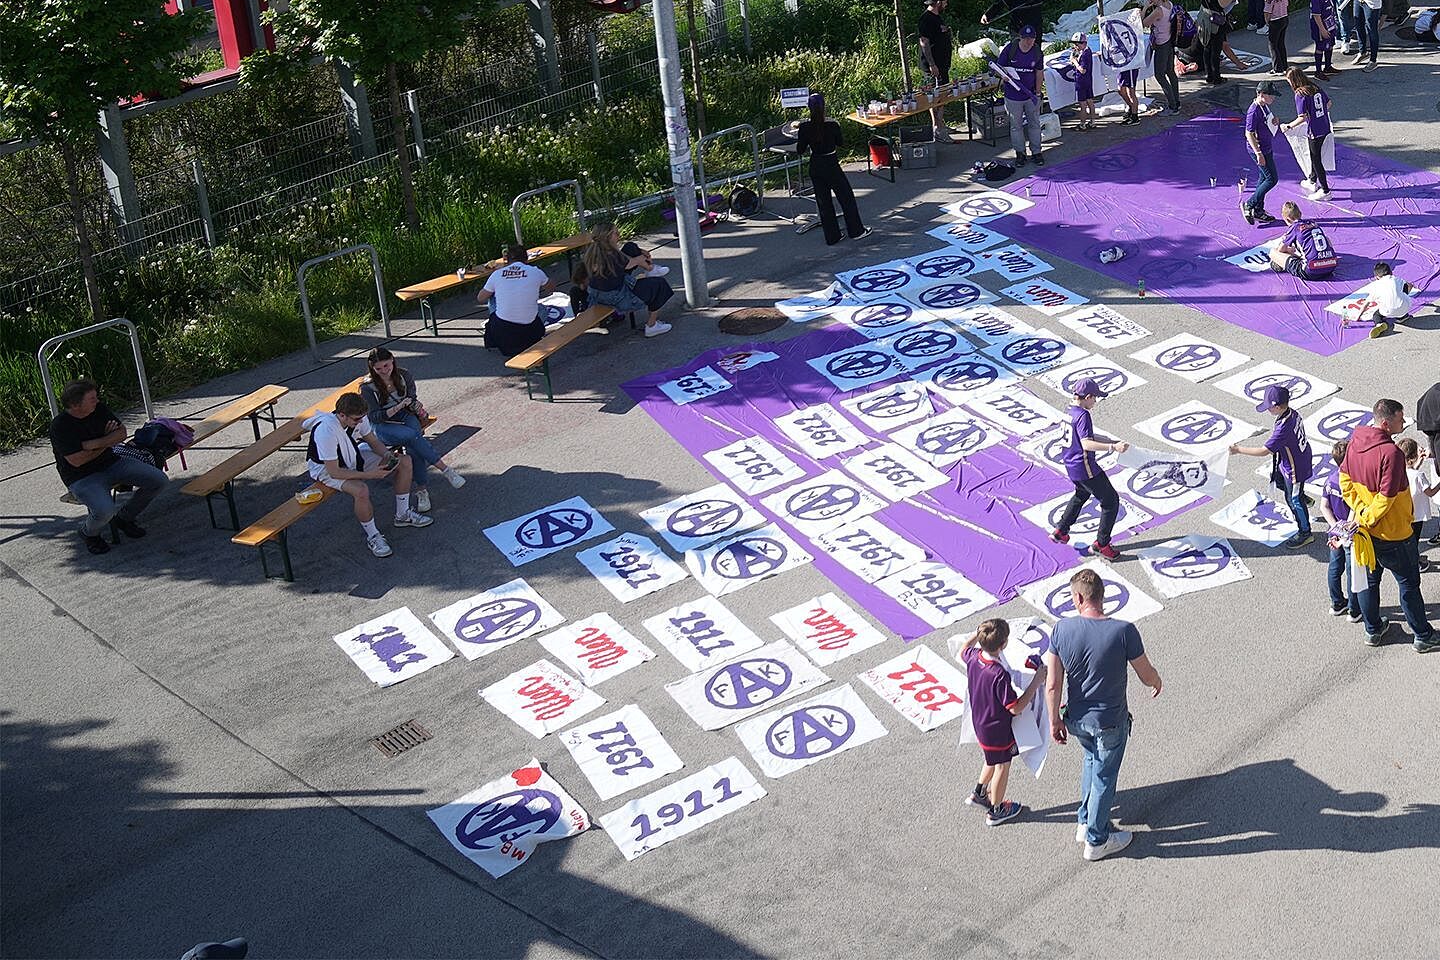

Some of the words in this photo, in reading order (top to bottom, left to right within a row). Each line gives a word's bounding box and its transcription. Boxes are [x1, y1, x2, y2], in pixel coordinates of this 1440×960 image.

[1077, 312, 1134, 340] 1911
[792, 412, 846, 446] 1911
[986, 395, 1047, 424] 1911
[724, 445, 784, 481] 1911
[864, 455, 926, 488] 1911
[836, 528, 905, 566] 1911
[599, 546, 661, 590] 1911
[900, 572, 972, 615] 1911
[669, 610, 735, 657] 1911
[887, 661, 964, 712] 1911
[588, 720, 655, 776] 1911
[631, 776, 743, 842] 1911
